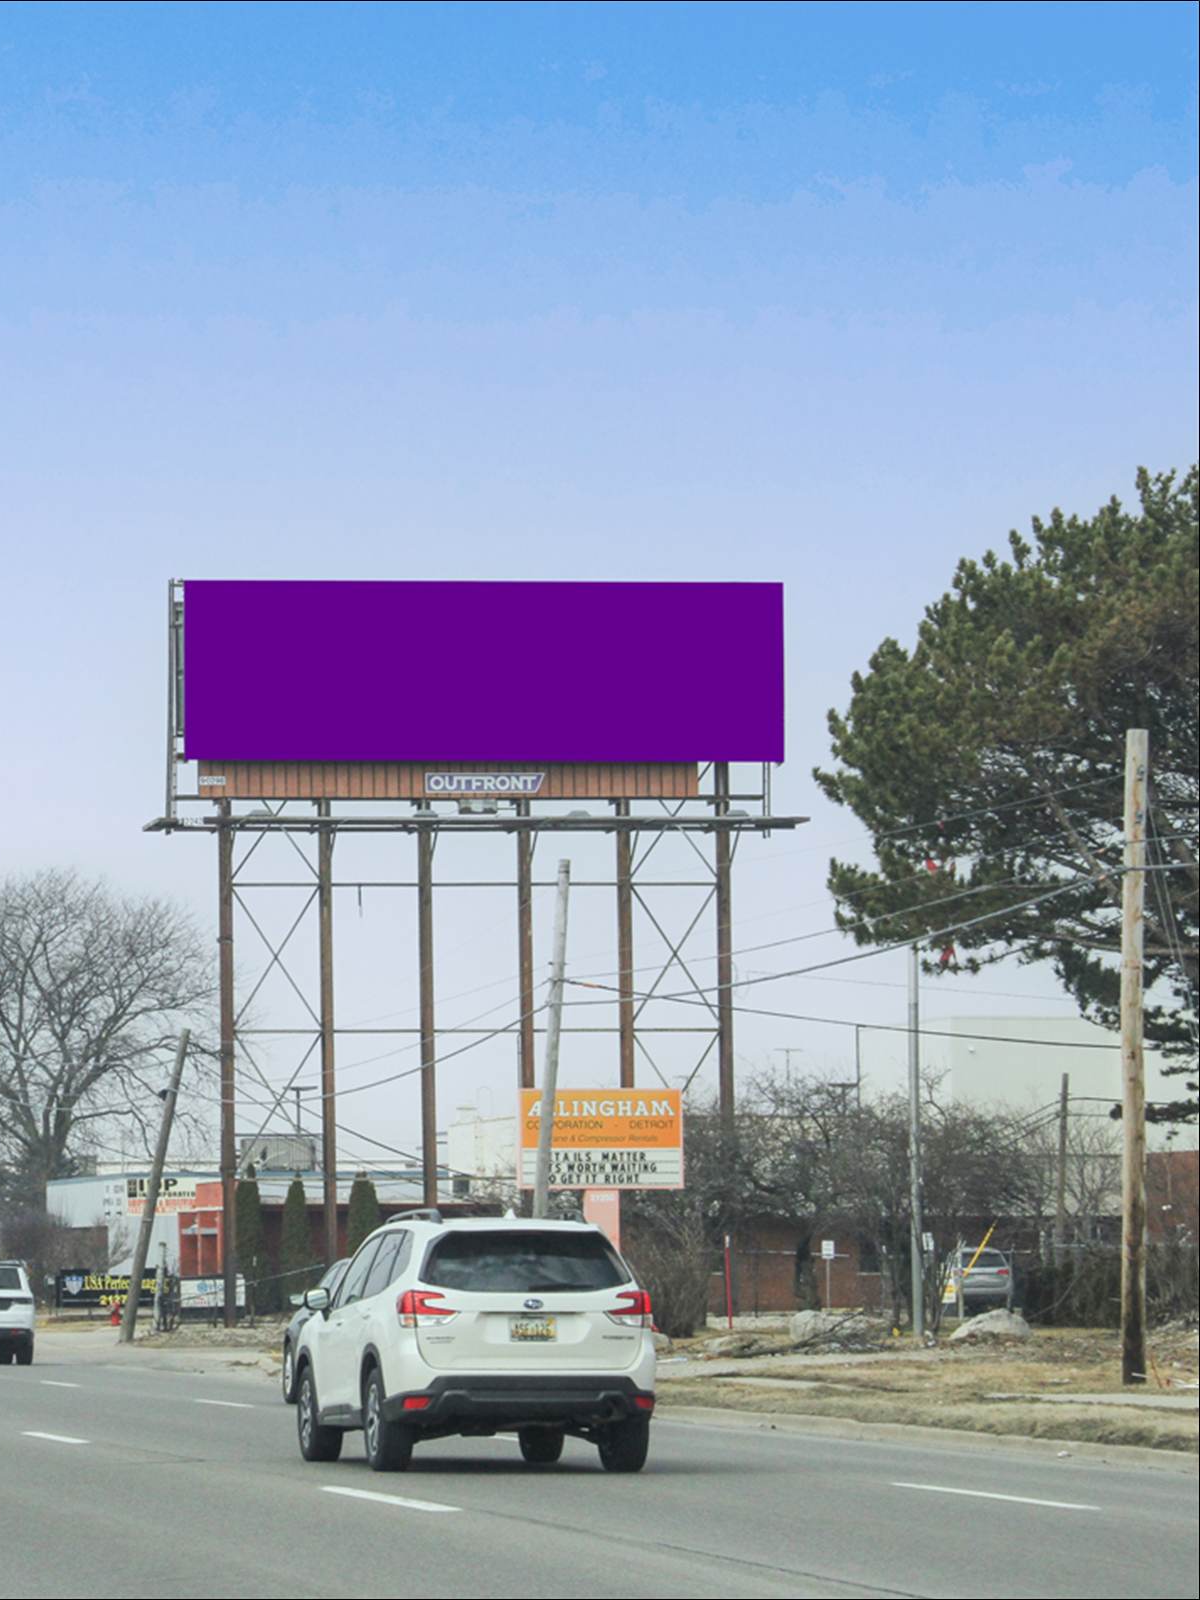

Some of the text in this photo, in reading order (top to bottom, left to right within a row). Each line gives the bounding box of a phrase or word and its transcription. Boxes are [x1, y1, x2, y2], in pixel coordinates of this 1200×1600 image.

[429, 776, 537, 790] OUTFRONT
[527, 1100, 676, 1117] ALINGHAM
[629, 1120, 675, 1130] DETROIT
[569, 1134, 576, 1143] &
[577, 1134, 626, 1144] Compressor
[628, 1134, 658, 1143] Rentals
[601, 1152, 647, 1162] MATTER
[567, 1162, 606, 1173] WORTH
[611, 1162, 658, 1173] WAITING
[560, 1174, 581, 1184] GET
[585, 1174, 597, 1184] IT
[604, 1174, 640, 1184] RIGHT
[84, 1275, 103, 1290] USA
